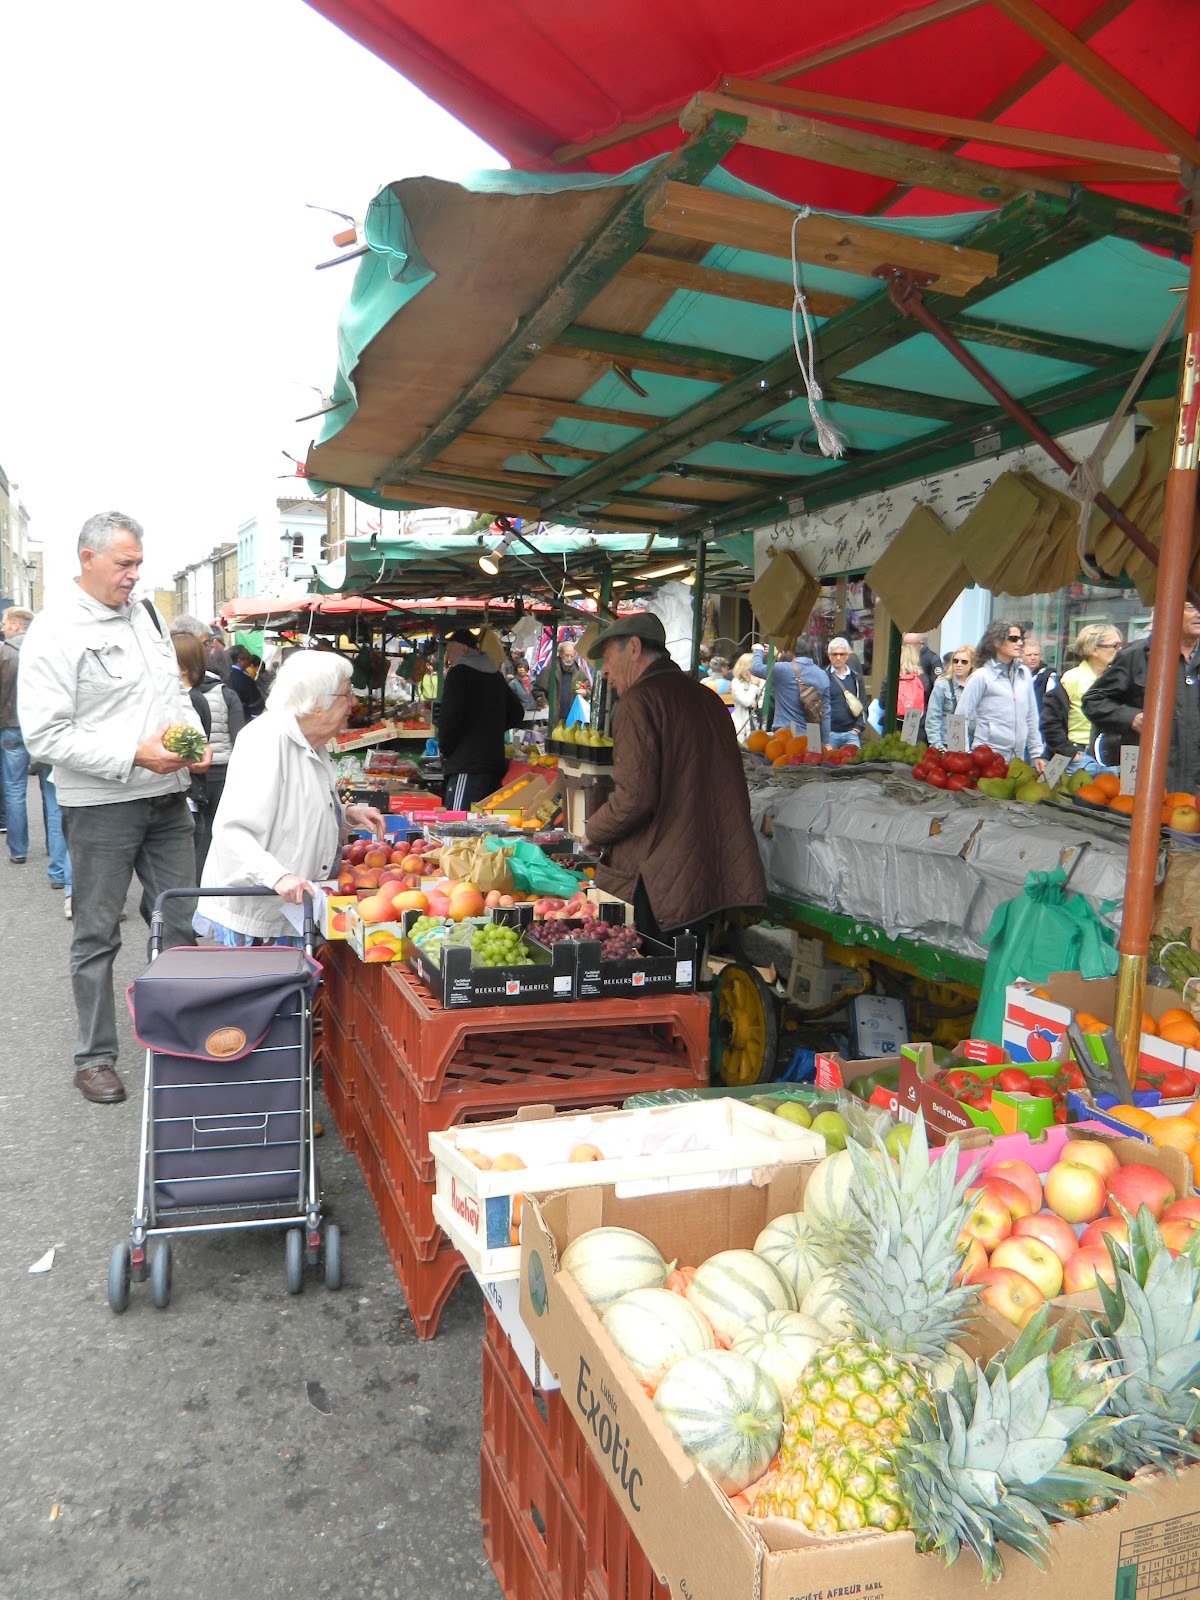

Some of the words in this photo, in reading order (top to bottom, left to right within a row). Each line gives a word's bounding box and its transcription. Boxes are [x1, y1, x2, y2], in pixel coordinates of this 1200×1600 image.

[475, 986, 505, 994] BEEKERS
[520, 983, 549, 991] BERRIES
[932, 1101, 946, 1116] Bella
[946, 1109, 967, 1127] Donna
[576, 1354, 643, 1512] Exotic
